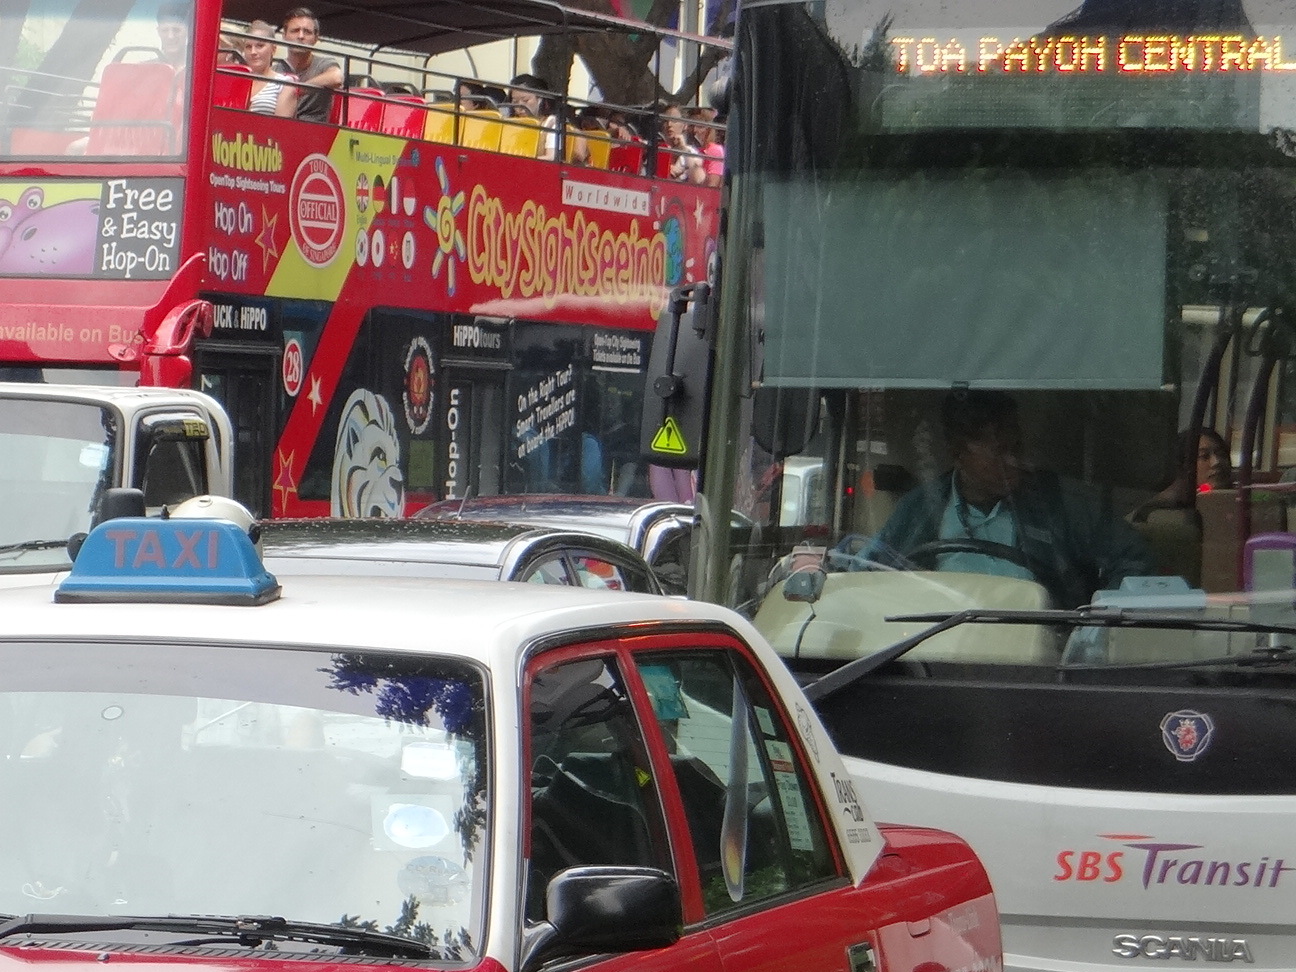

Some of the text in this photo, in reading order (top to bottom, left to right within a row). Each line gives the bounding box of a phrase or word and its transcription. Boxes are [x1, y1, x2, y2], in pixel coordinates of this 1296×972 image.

[890, 34, 1296, 73] TOA PAYOH CENTRAL
[211, 132, 283, 173] Worldwide
[106, 179, 174, 212] Free
[300, 200, 337, 221] OFFICIAL
[565, 185, 648, 213] Worldwide
[101, 212, 177, 248] & Easy
[214, 201, 253, 236] Hop On
[101, 241, 171, 279] Hop-On
[208, 246, 249, 282] Hop Off
[213, 304, 233, 329] UCK
[79, 327, 102, 343] on
[285, 350, 299, 383] 28
[517, 363, 573, 413] On the Right Tour?
[516, 411, 535, 438] Smart
[565, 389, 576, 406] are
[445, 388, 460, 500] Hop-On
[517, 442, 526, 459] on
[526, 426, 544, 454] board
[544, 421, 555, 442] the
[105, 529, 220, 570] TAXI
[1053, 843, 1296, 890] SBS Transit
[1112, 933, 1255, 963] SCANIA
